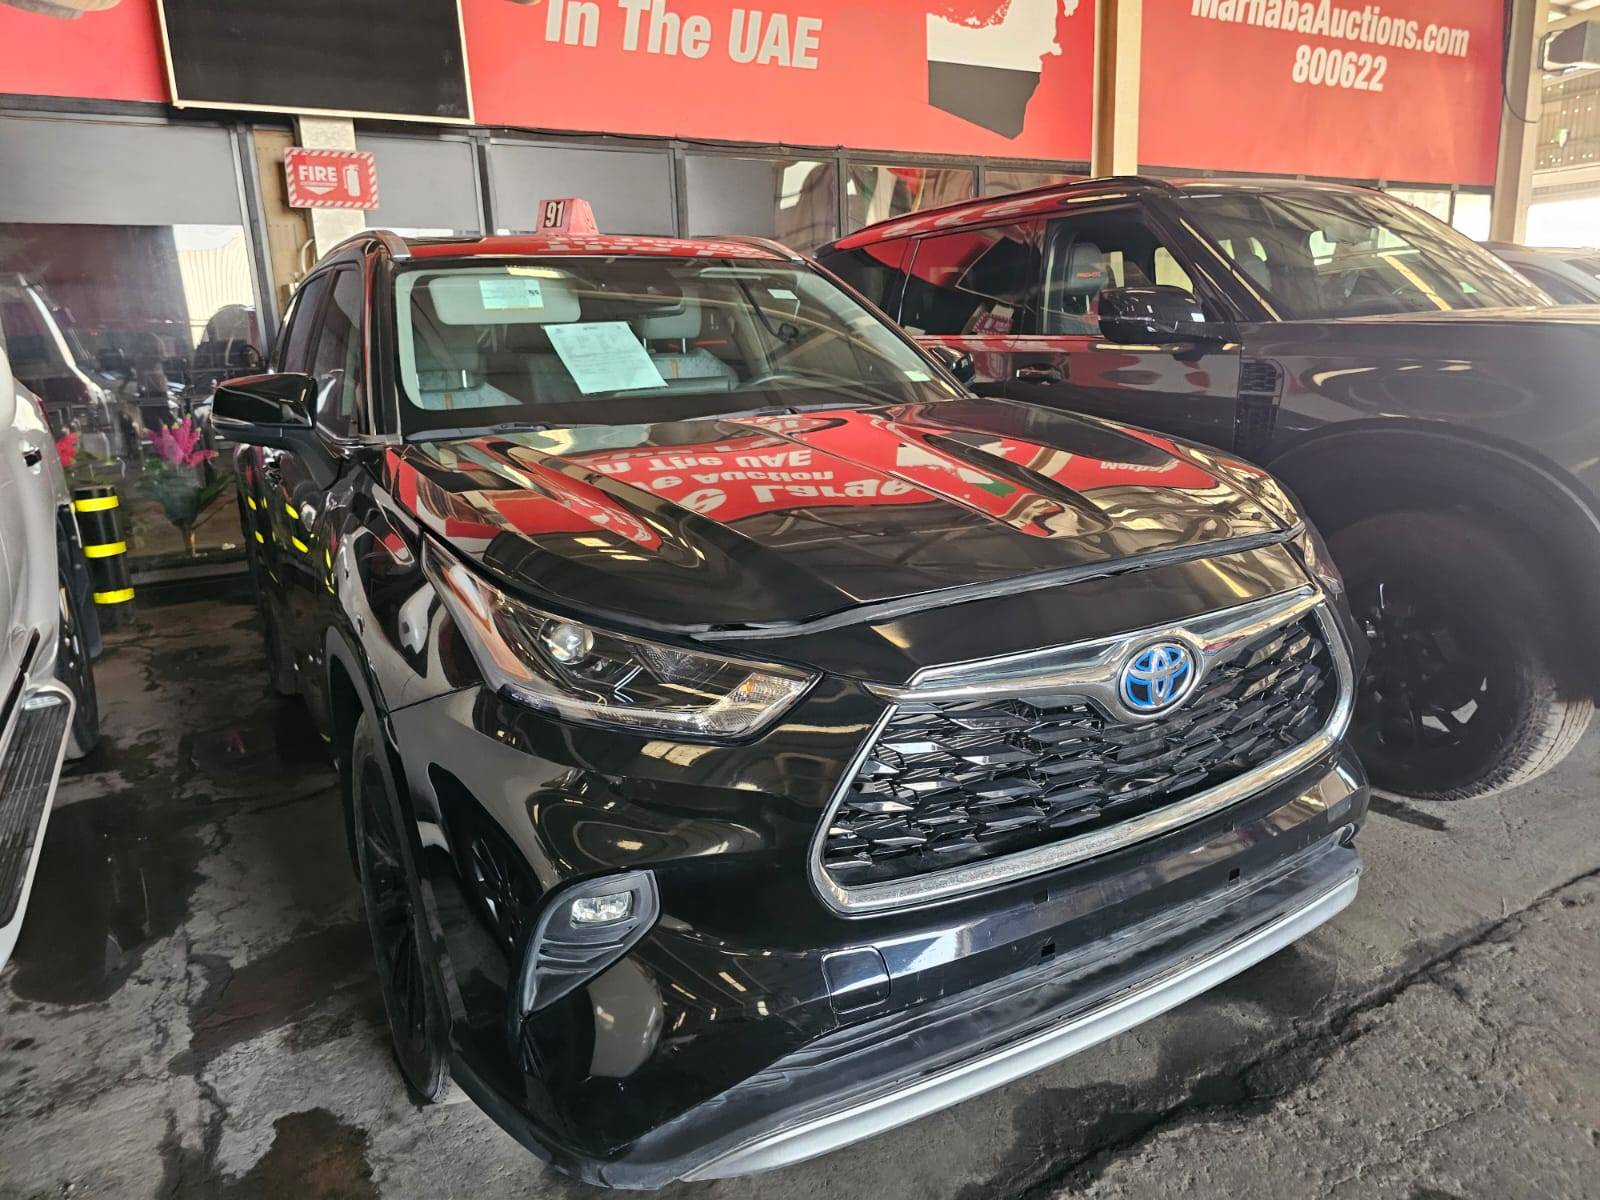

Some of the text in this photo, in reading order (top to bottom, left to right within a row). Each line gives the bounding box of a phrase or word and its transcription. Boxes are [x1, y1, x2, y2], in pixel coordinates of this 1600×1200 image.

[545, 0, 823, 69] In The UAE
[1292, 44, 1388, 92] 800622
[298, 165, 338, 182] FIRE
[545, 201, 565, 228] 91
